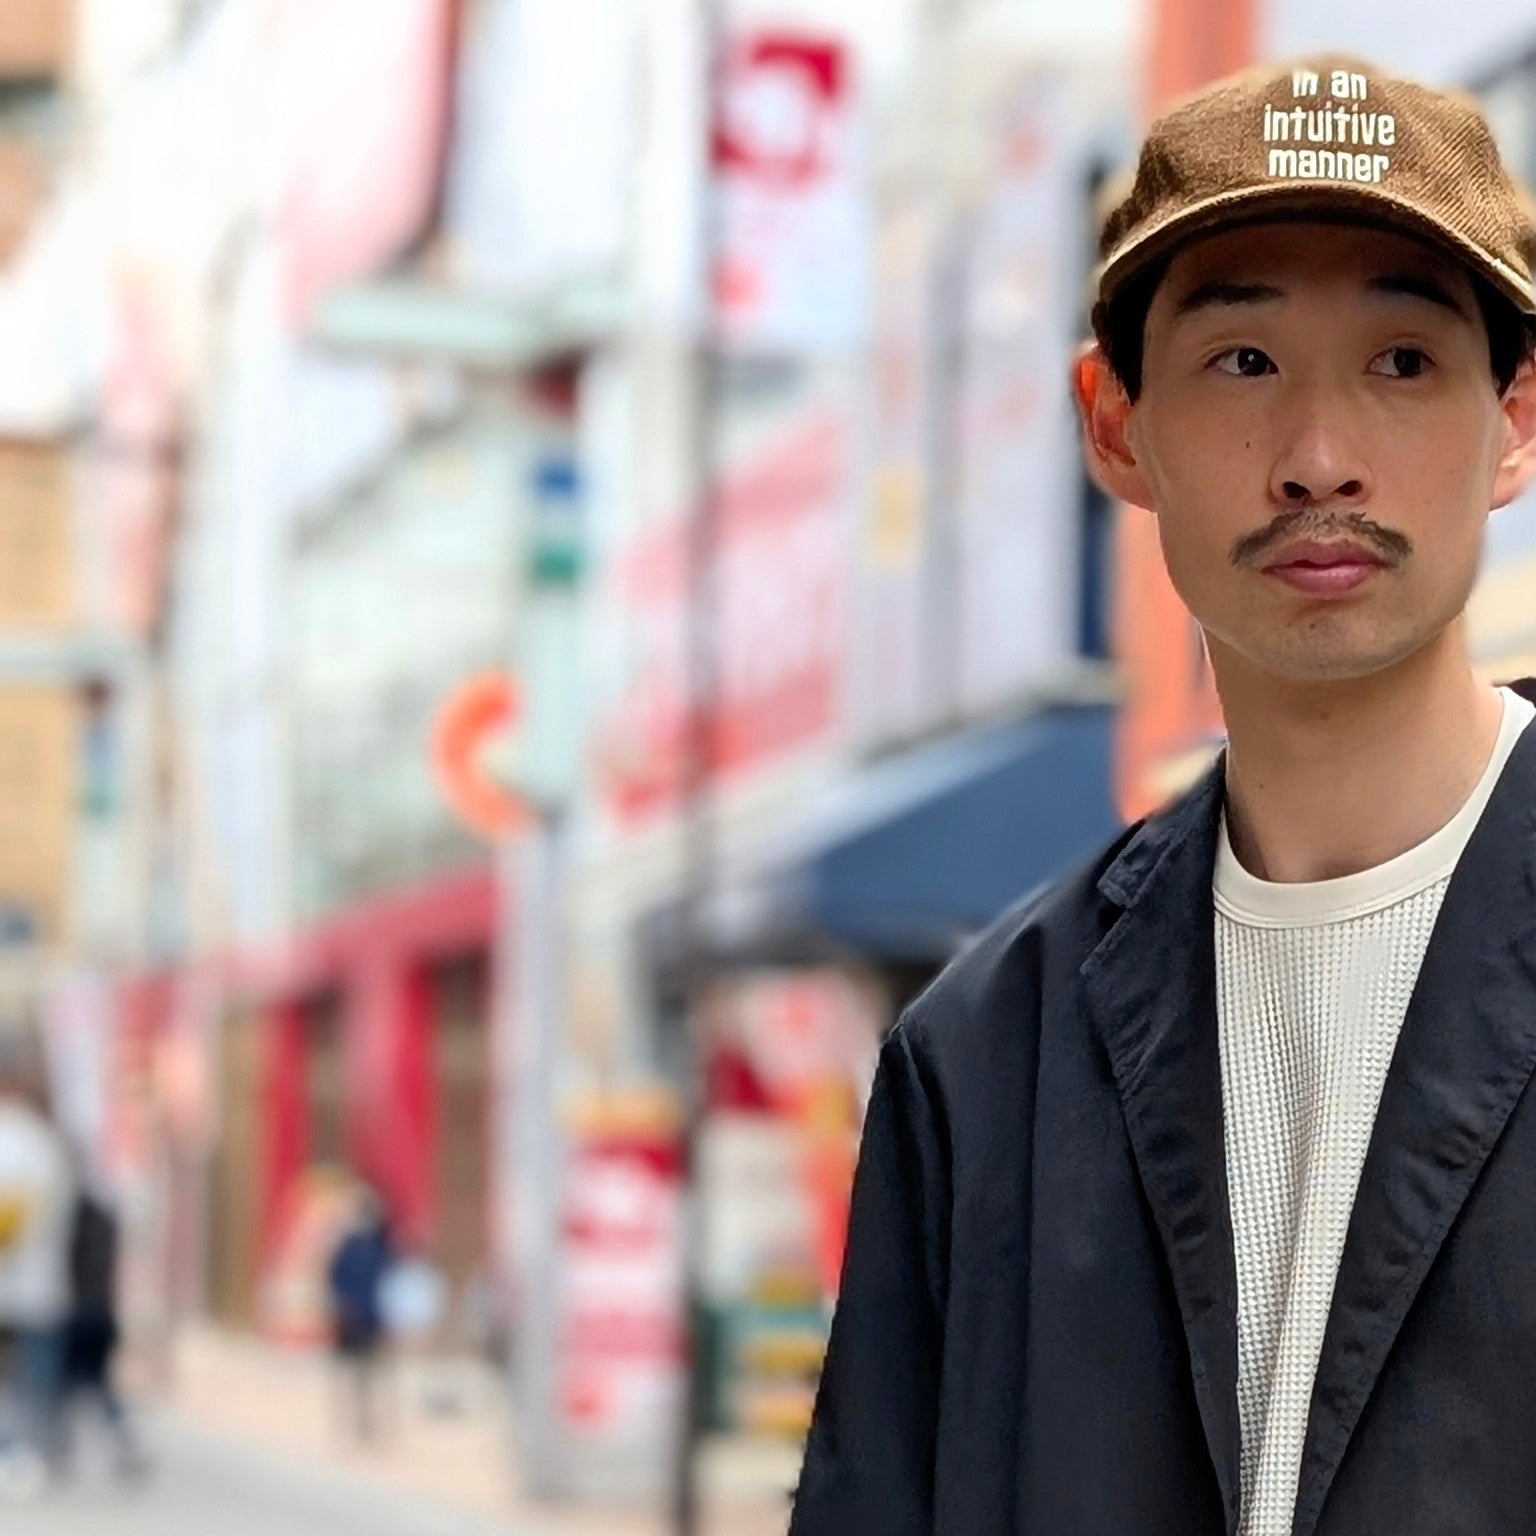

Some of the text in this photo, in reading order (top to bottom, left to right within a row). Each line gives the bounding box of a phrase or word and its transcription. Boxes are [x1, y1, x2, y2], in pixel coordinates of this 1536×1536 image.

[1331, 70, 1367, 100] an
[1263, 101, 1395, 145] intuitive
[1268, 149, 1389, 182] manner
